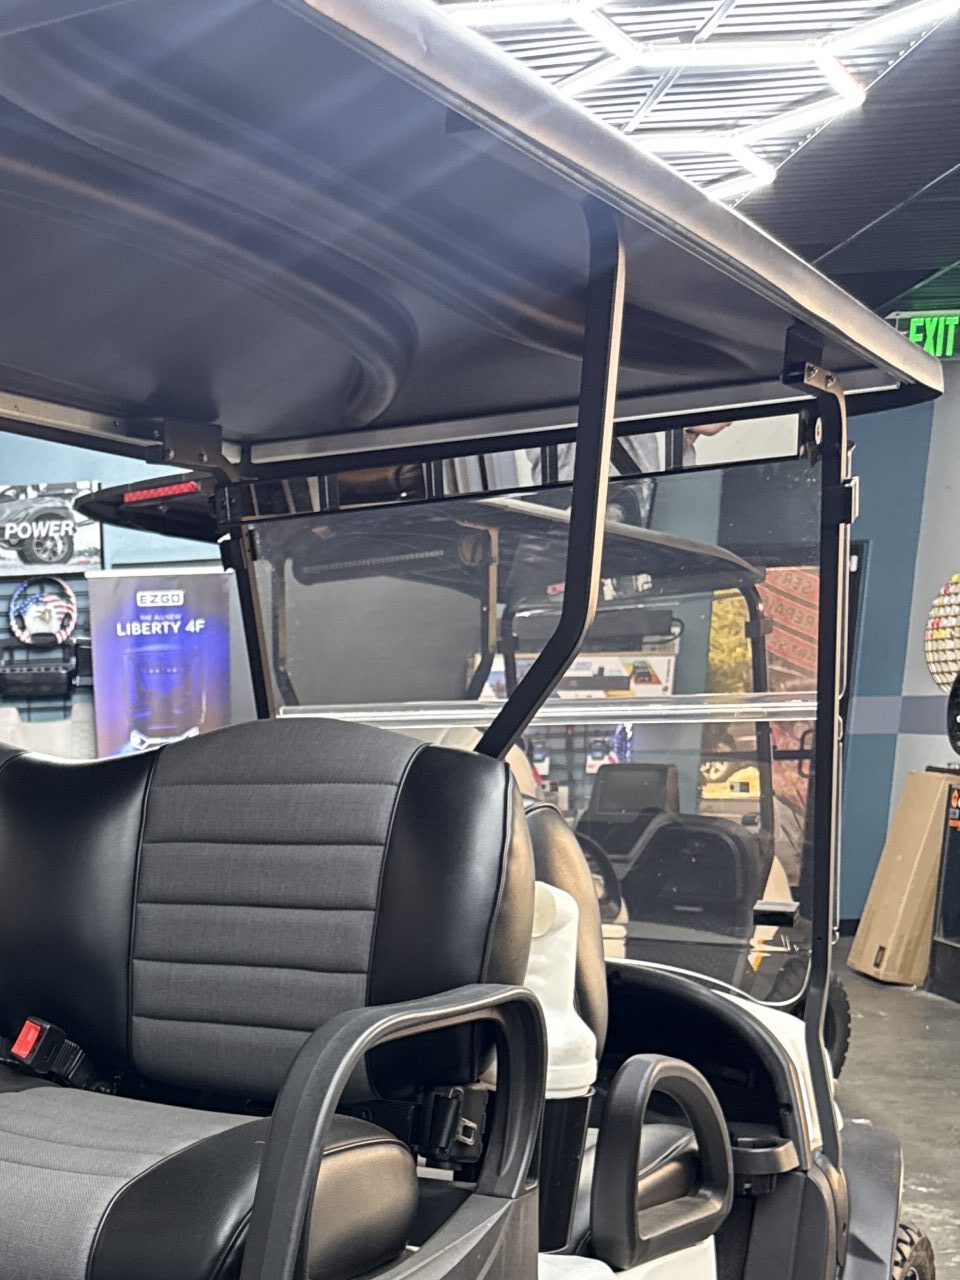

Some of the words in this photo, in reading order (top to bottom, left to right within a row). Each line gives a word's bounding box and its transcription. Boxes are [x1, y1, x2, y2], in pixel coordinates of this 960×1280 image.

[909, 316, 959, 357] EXIT
[5, 519, 75, 539] POWER
[138, 593, 182, 605] EZGO
[116, 620, 182, 636] LIBERTY
[185, 618, 206, 633] 4F
